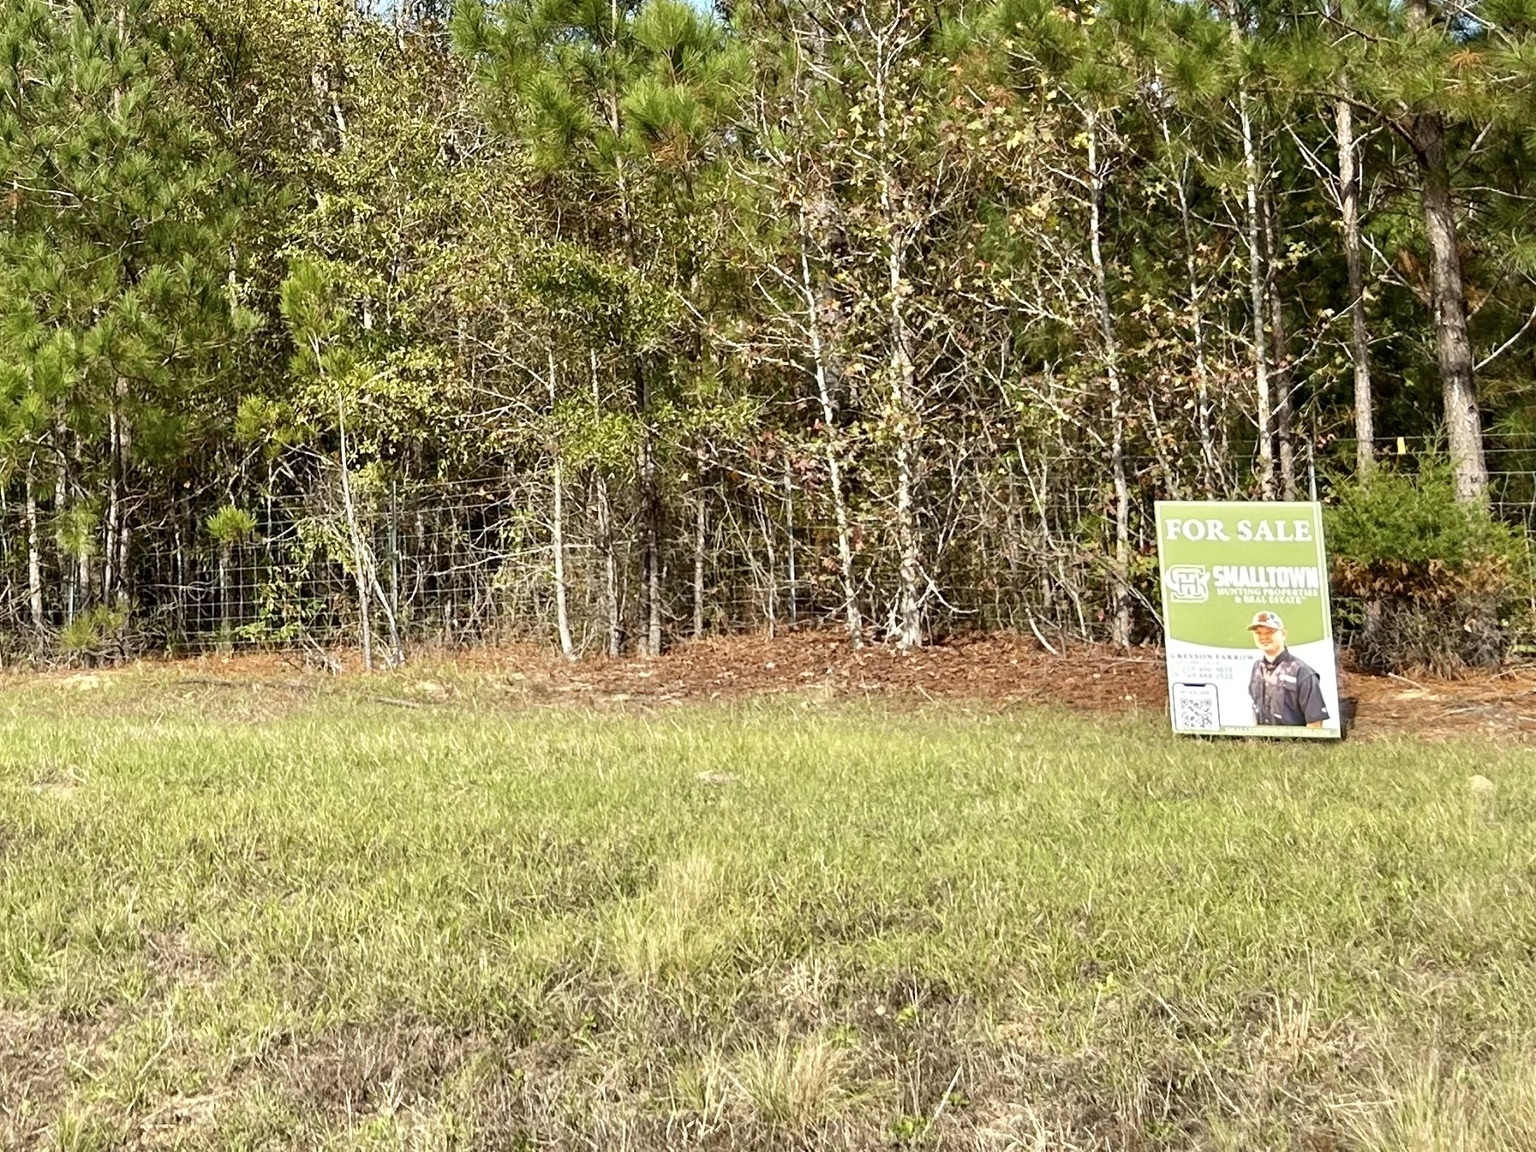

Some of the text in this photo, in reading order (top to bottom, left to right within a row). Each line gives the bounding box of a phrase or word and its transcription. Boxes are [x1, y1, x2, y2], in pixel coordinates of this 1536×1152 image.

[1165, 519, 1313, 542] FOR SALE
[1213, 565, 1319, 589] SMALLTOWN
[1216, 587, 1319, 597] HUNTING PROPERTIES
[1244, 595, 1267, 604] REAL
